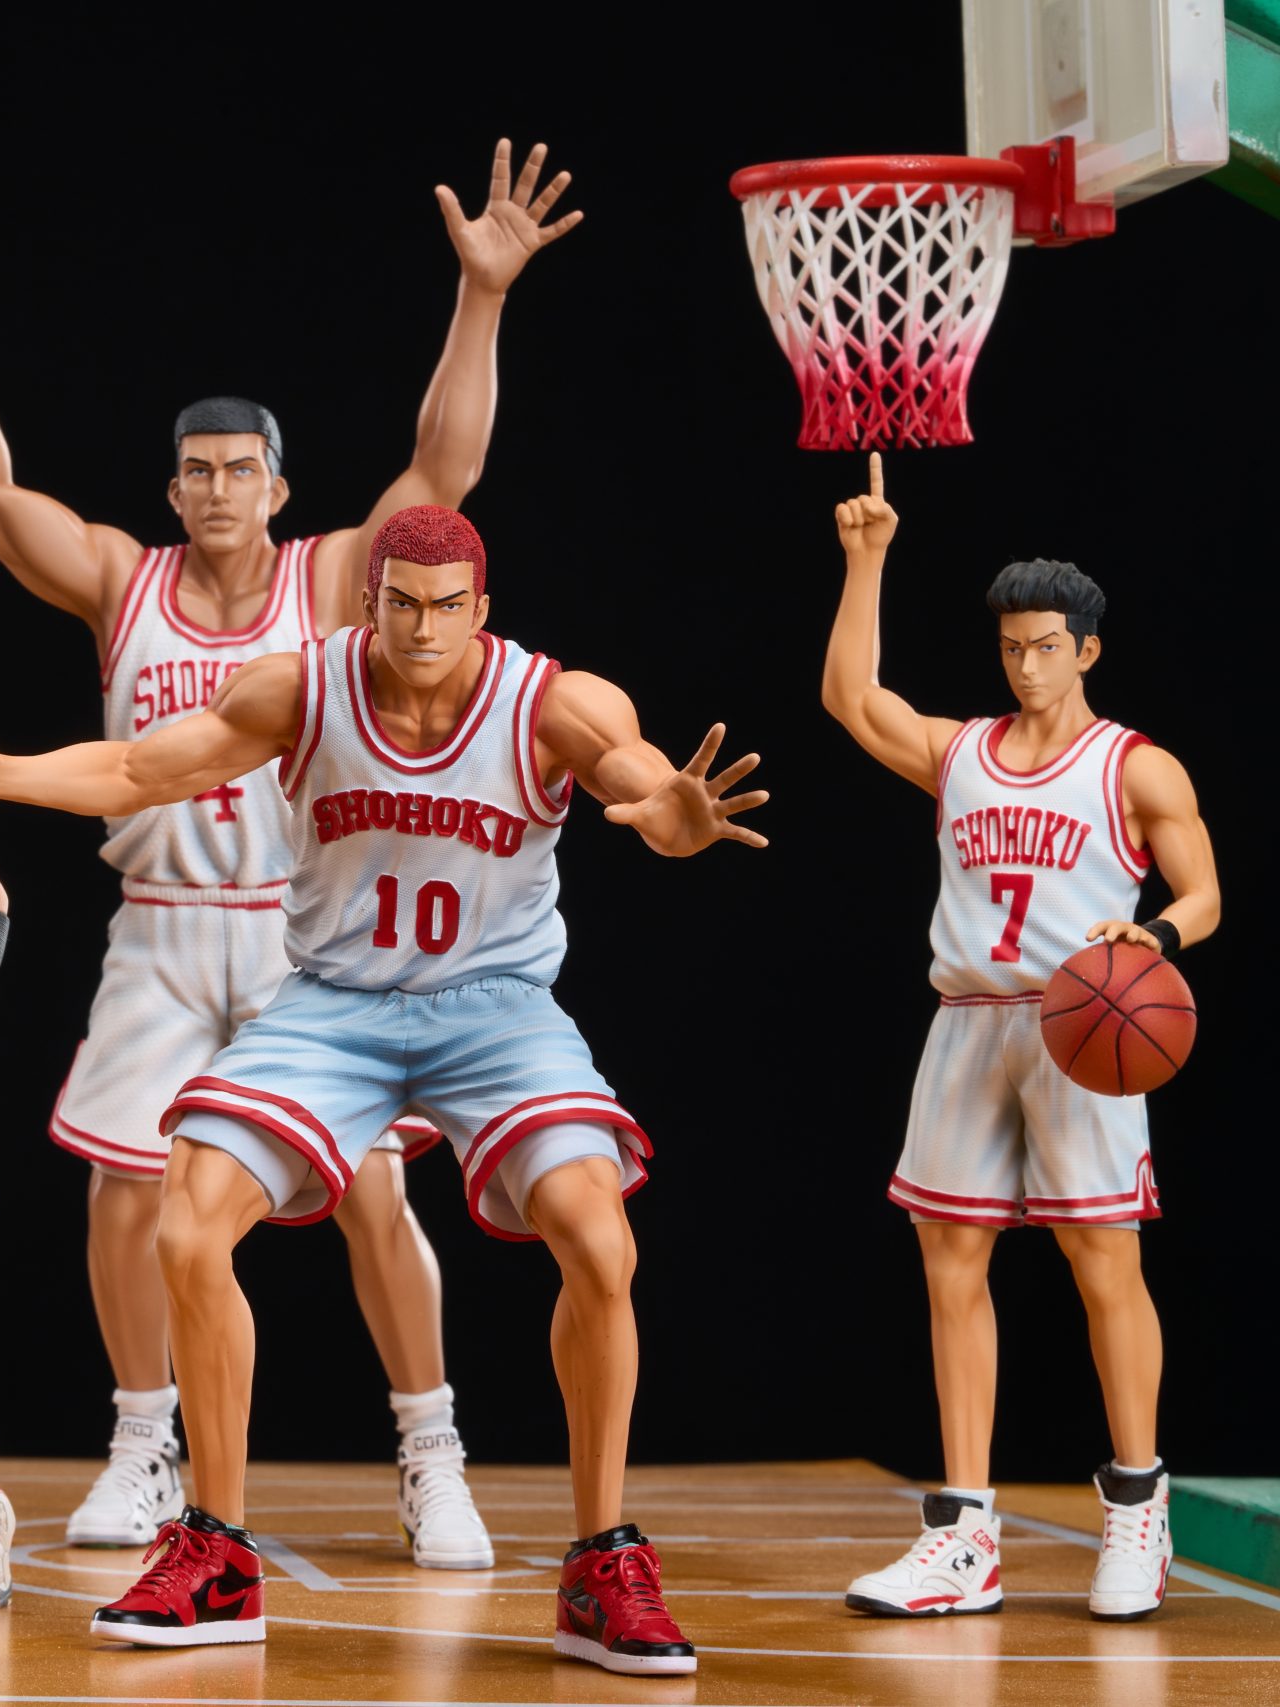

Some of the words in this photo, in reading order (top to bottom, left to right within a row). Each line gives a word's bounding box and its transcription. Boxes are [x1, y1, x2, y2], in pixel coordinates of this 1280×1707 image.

[311, 788, 529, 858] SHOHOKU
[951, 805, 1093, 871] SHOHOKU
[372, 873, 461, 955] 10
[990, 872, 1034, 963] 7
